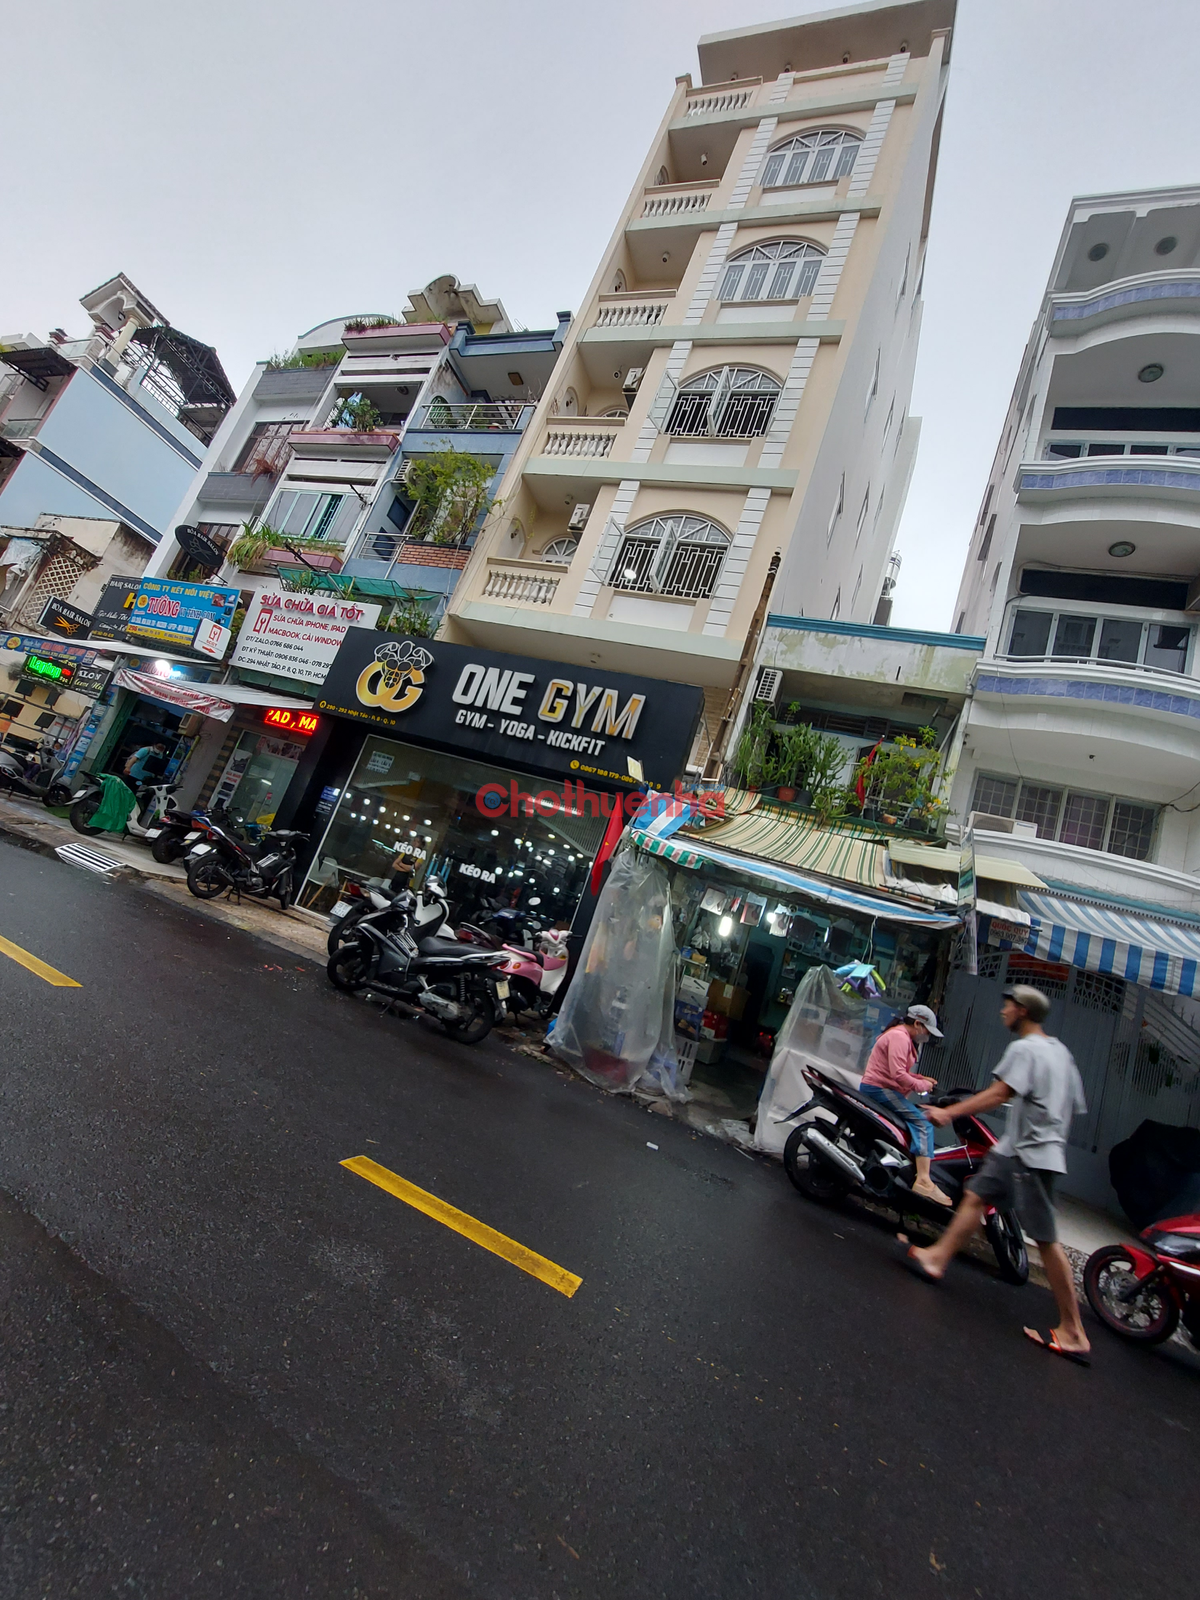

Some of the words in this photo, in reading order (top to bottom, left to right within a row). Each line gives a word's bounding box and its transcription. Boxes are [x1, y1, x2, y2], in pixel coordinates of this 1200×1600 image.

[143, 582, 161, 591] CÔNG
[162, 585, 170, 593] TY
[260, 592, 281, 609] SỬA
[284, 597, 315, 614] CHỮA
[316, 602, 337, 618] GIÁ
[340, 602, 364, 621] TỐT
[75, 615, 92, 628] SALON
[304, 620, 330, 632] IPHONE,
[330, 625, 346, 633] IPAD
[268, 627, 301, 640] MACBOOK,
[29, 656, 62, 679] Laptop
[452, 663, 536, 716] ONE
[537, 678, 646, 740] GYM
[455, 709, 489, 729] GYM
[499, 718, 536, 741] YOGA
[547, 729, 605, 756] KICKFIT
[580, 765, 596, 774] 0867
[393, 841, 413, 855] KÉO
[413, 848, 427, 861] RA
[459, 863, 481, 878] KÉO
[480, 870, 496, 884] RA
